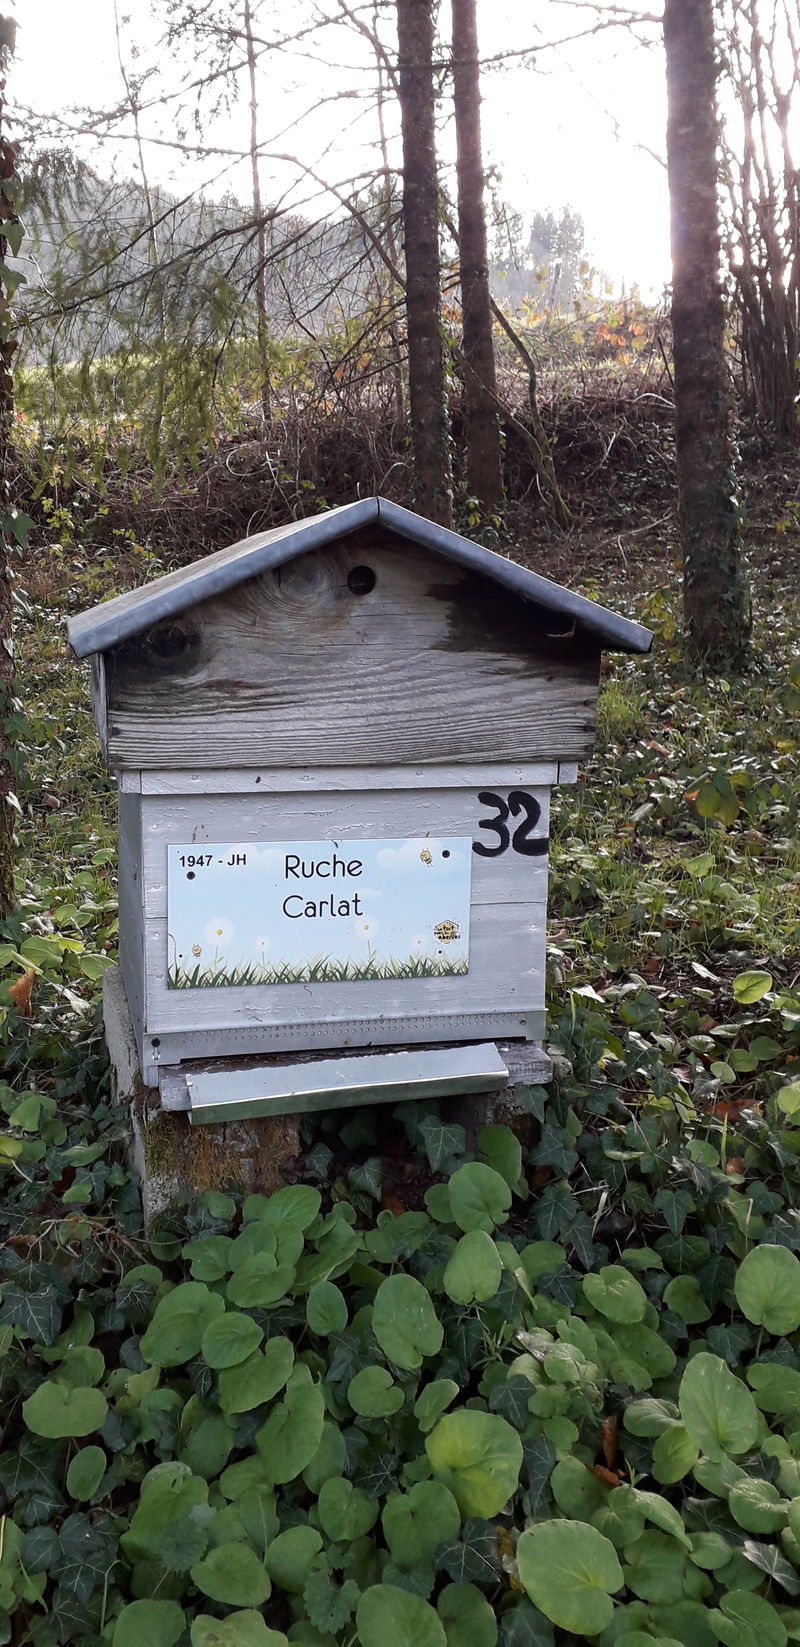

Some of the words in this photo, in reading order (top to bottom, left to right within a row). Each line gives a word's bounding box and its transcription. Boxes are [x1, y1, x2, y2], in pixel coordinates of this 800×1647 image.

[472, 790, 549, 857] 32
[178, 854, 213, 867] 1947
[227, 853, 247, 866] JH
[285, 854, 363, 878] Ruche
[282, 893, 364, 919] Carlat
